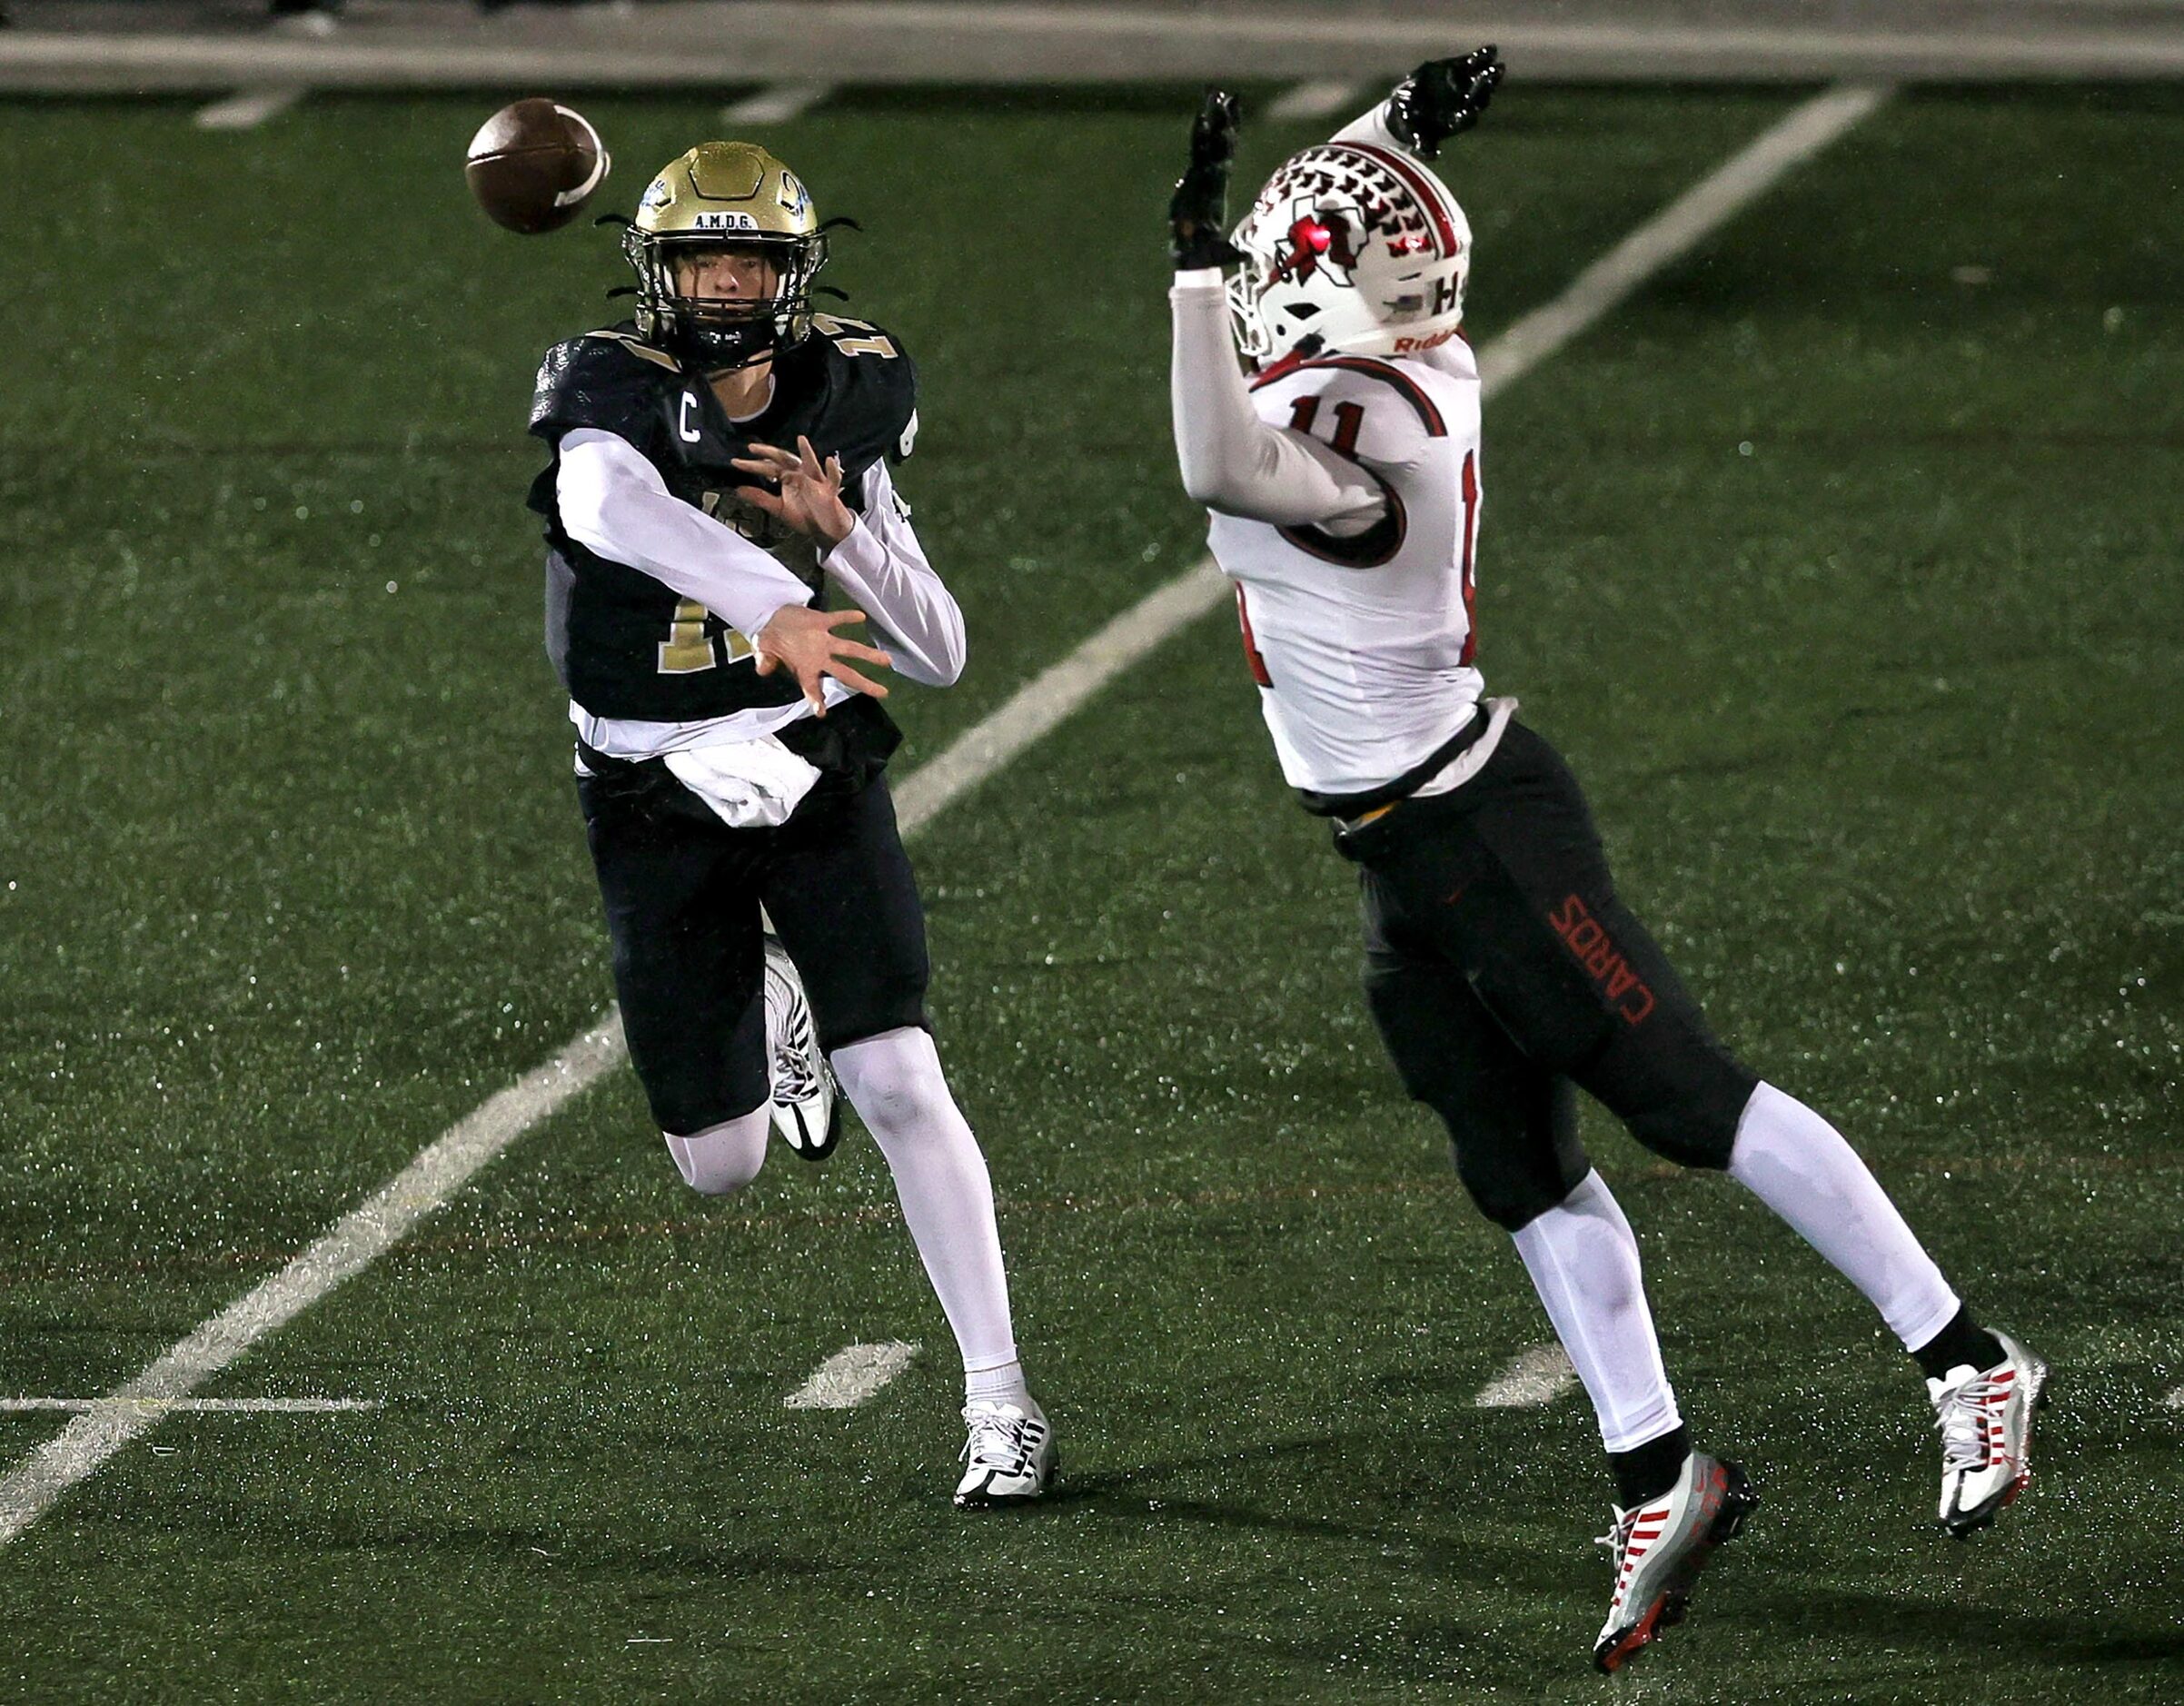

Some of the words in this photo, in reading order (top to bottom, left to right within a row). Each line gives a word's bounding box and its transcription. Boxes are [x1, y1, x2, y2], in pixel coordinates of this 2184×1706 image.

[695, 214, 752, 229] A.M.D.G.
[679, 390, 701, 442] C
[1289, 394, 1365, 462] 11
[1548, 892, 1657, 1026] CARDS
